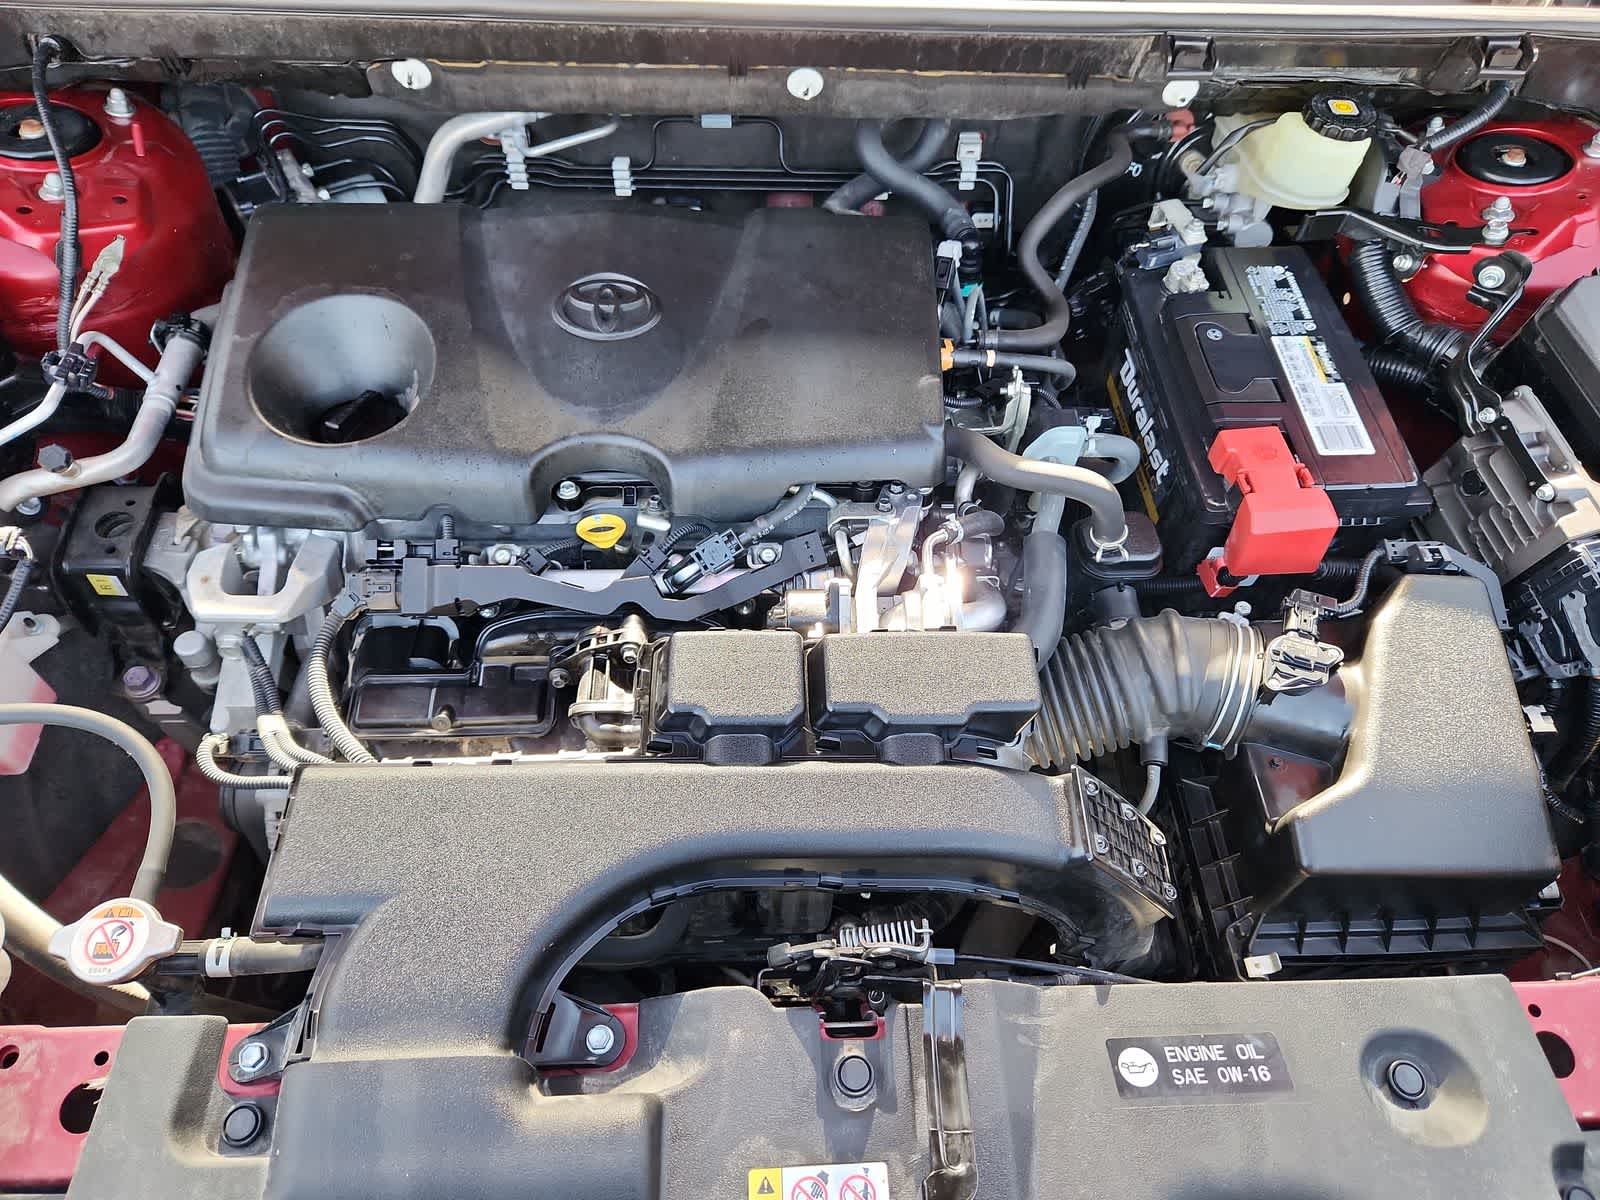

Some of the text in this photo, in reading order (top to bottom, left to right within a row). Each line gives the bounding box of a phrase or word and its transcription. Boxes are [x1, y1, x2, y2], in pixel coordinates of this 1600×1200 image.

[1119, 347, 1170, 486] Duralast
[1163, 1043, 1265, 1063] ENGINE OIL
[1172, 1065, 1272, 1085] SAE 0W-16
